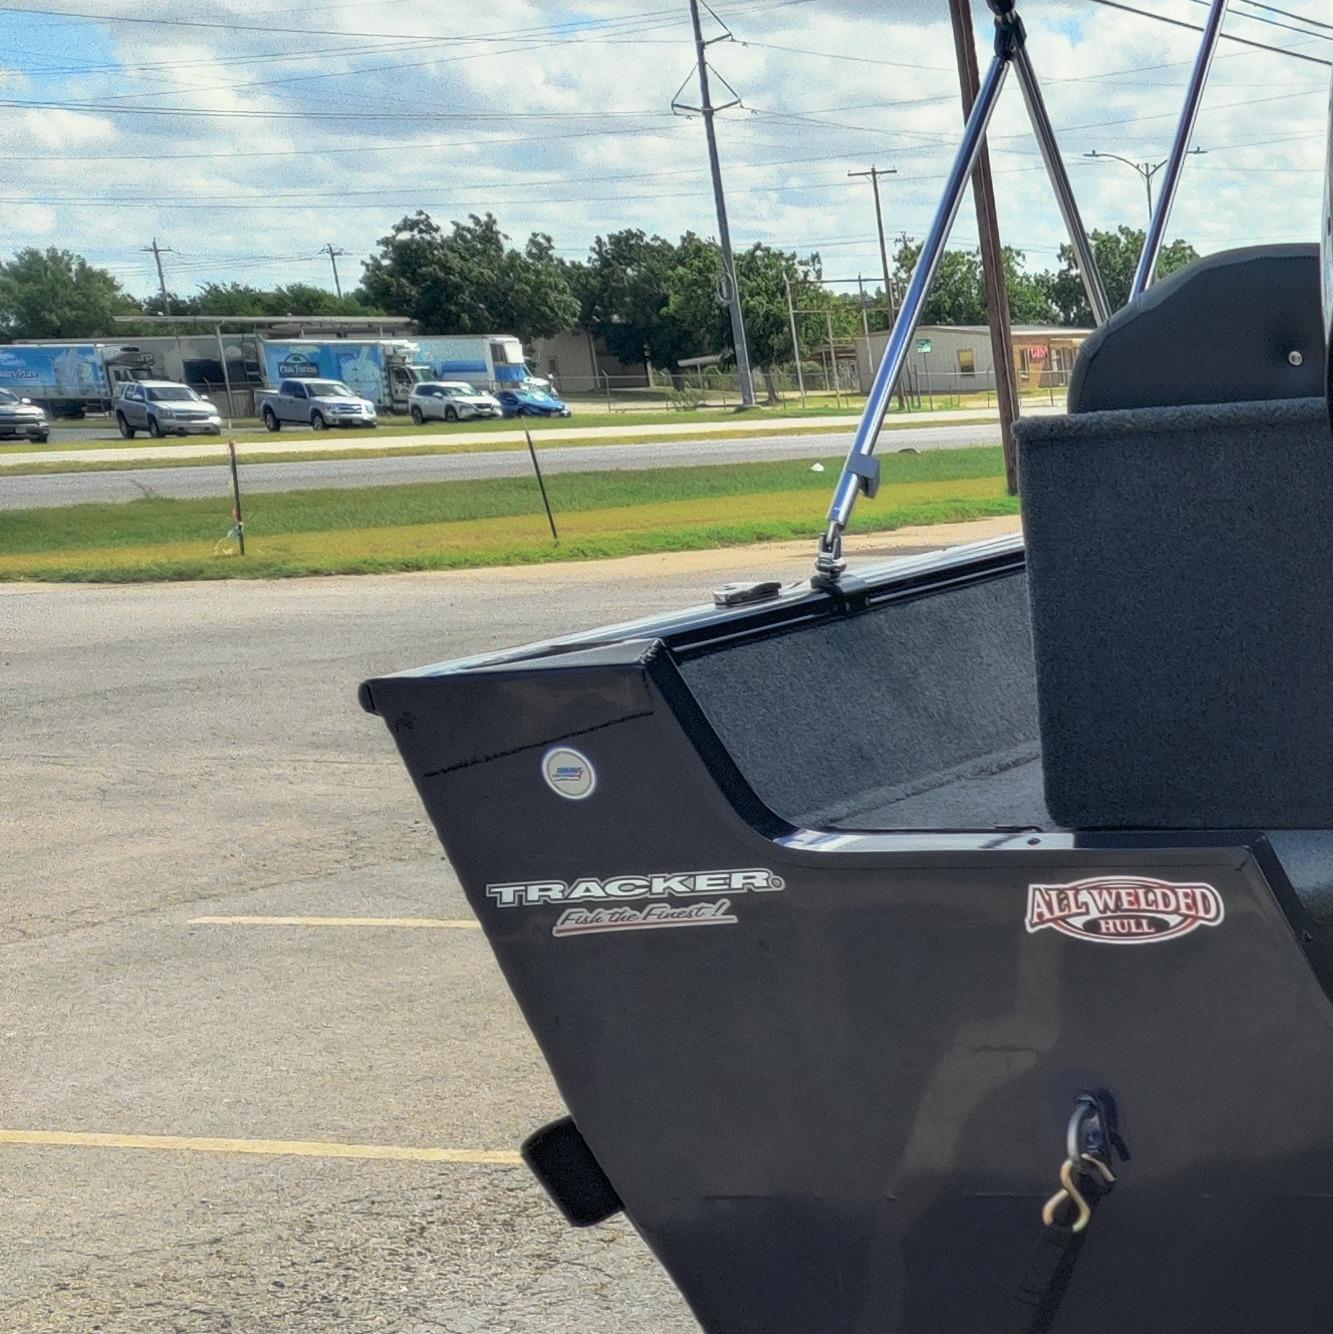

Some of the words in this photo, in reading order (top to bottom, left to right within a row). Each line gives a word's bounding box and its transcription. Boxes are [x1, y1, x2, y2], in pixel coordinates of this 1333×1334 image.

[490, 870, 770, 905] TRACKER
[560, 910, 604, 926] Fish
[607, 907, 639, 924] the
[1032, 888, 1088, 923] ALL
[1089, 888, 1217, 920] WELDED
[1098, 919, 1155, 934] HULL
